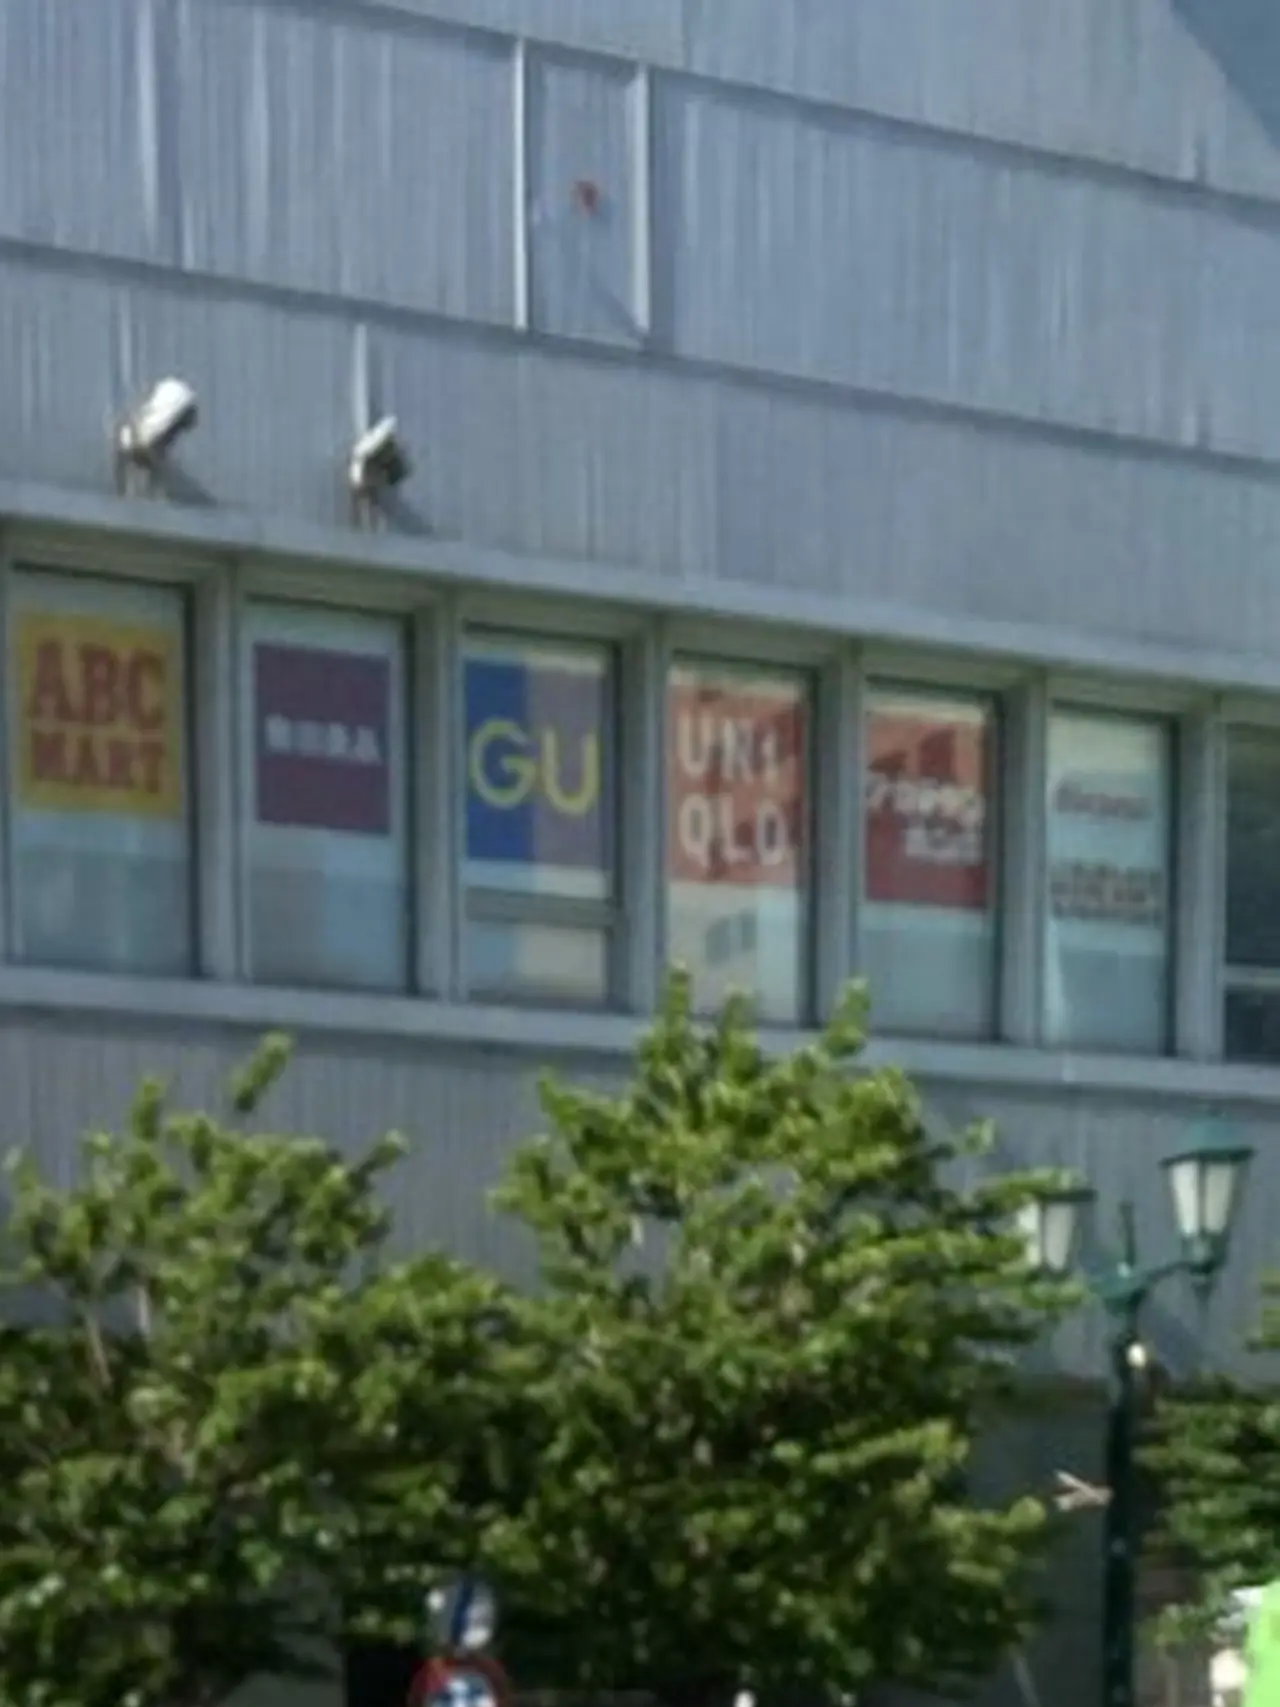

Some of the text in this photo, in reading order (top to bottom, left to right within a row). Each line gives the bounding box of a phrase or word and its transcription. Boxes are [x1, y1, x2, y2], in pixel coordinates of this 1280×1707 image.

[27, 637, 168, 731] ABC
[30, 728, 168, 794] MART
[468, 717, 601, 817] GU
[677, 794, 787, 869] QLO
